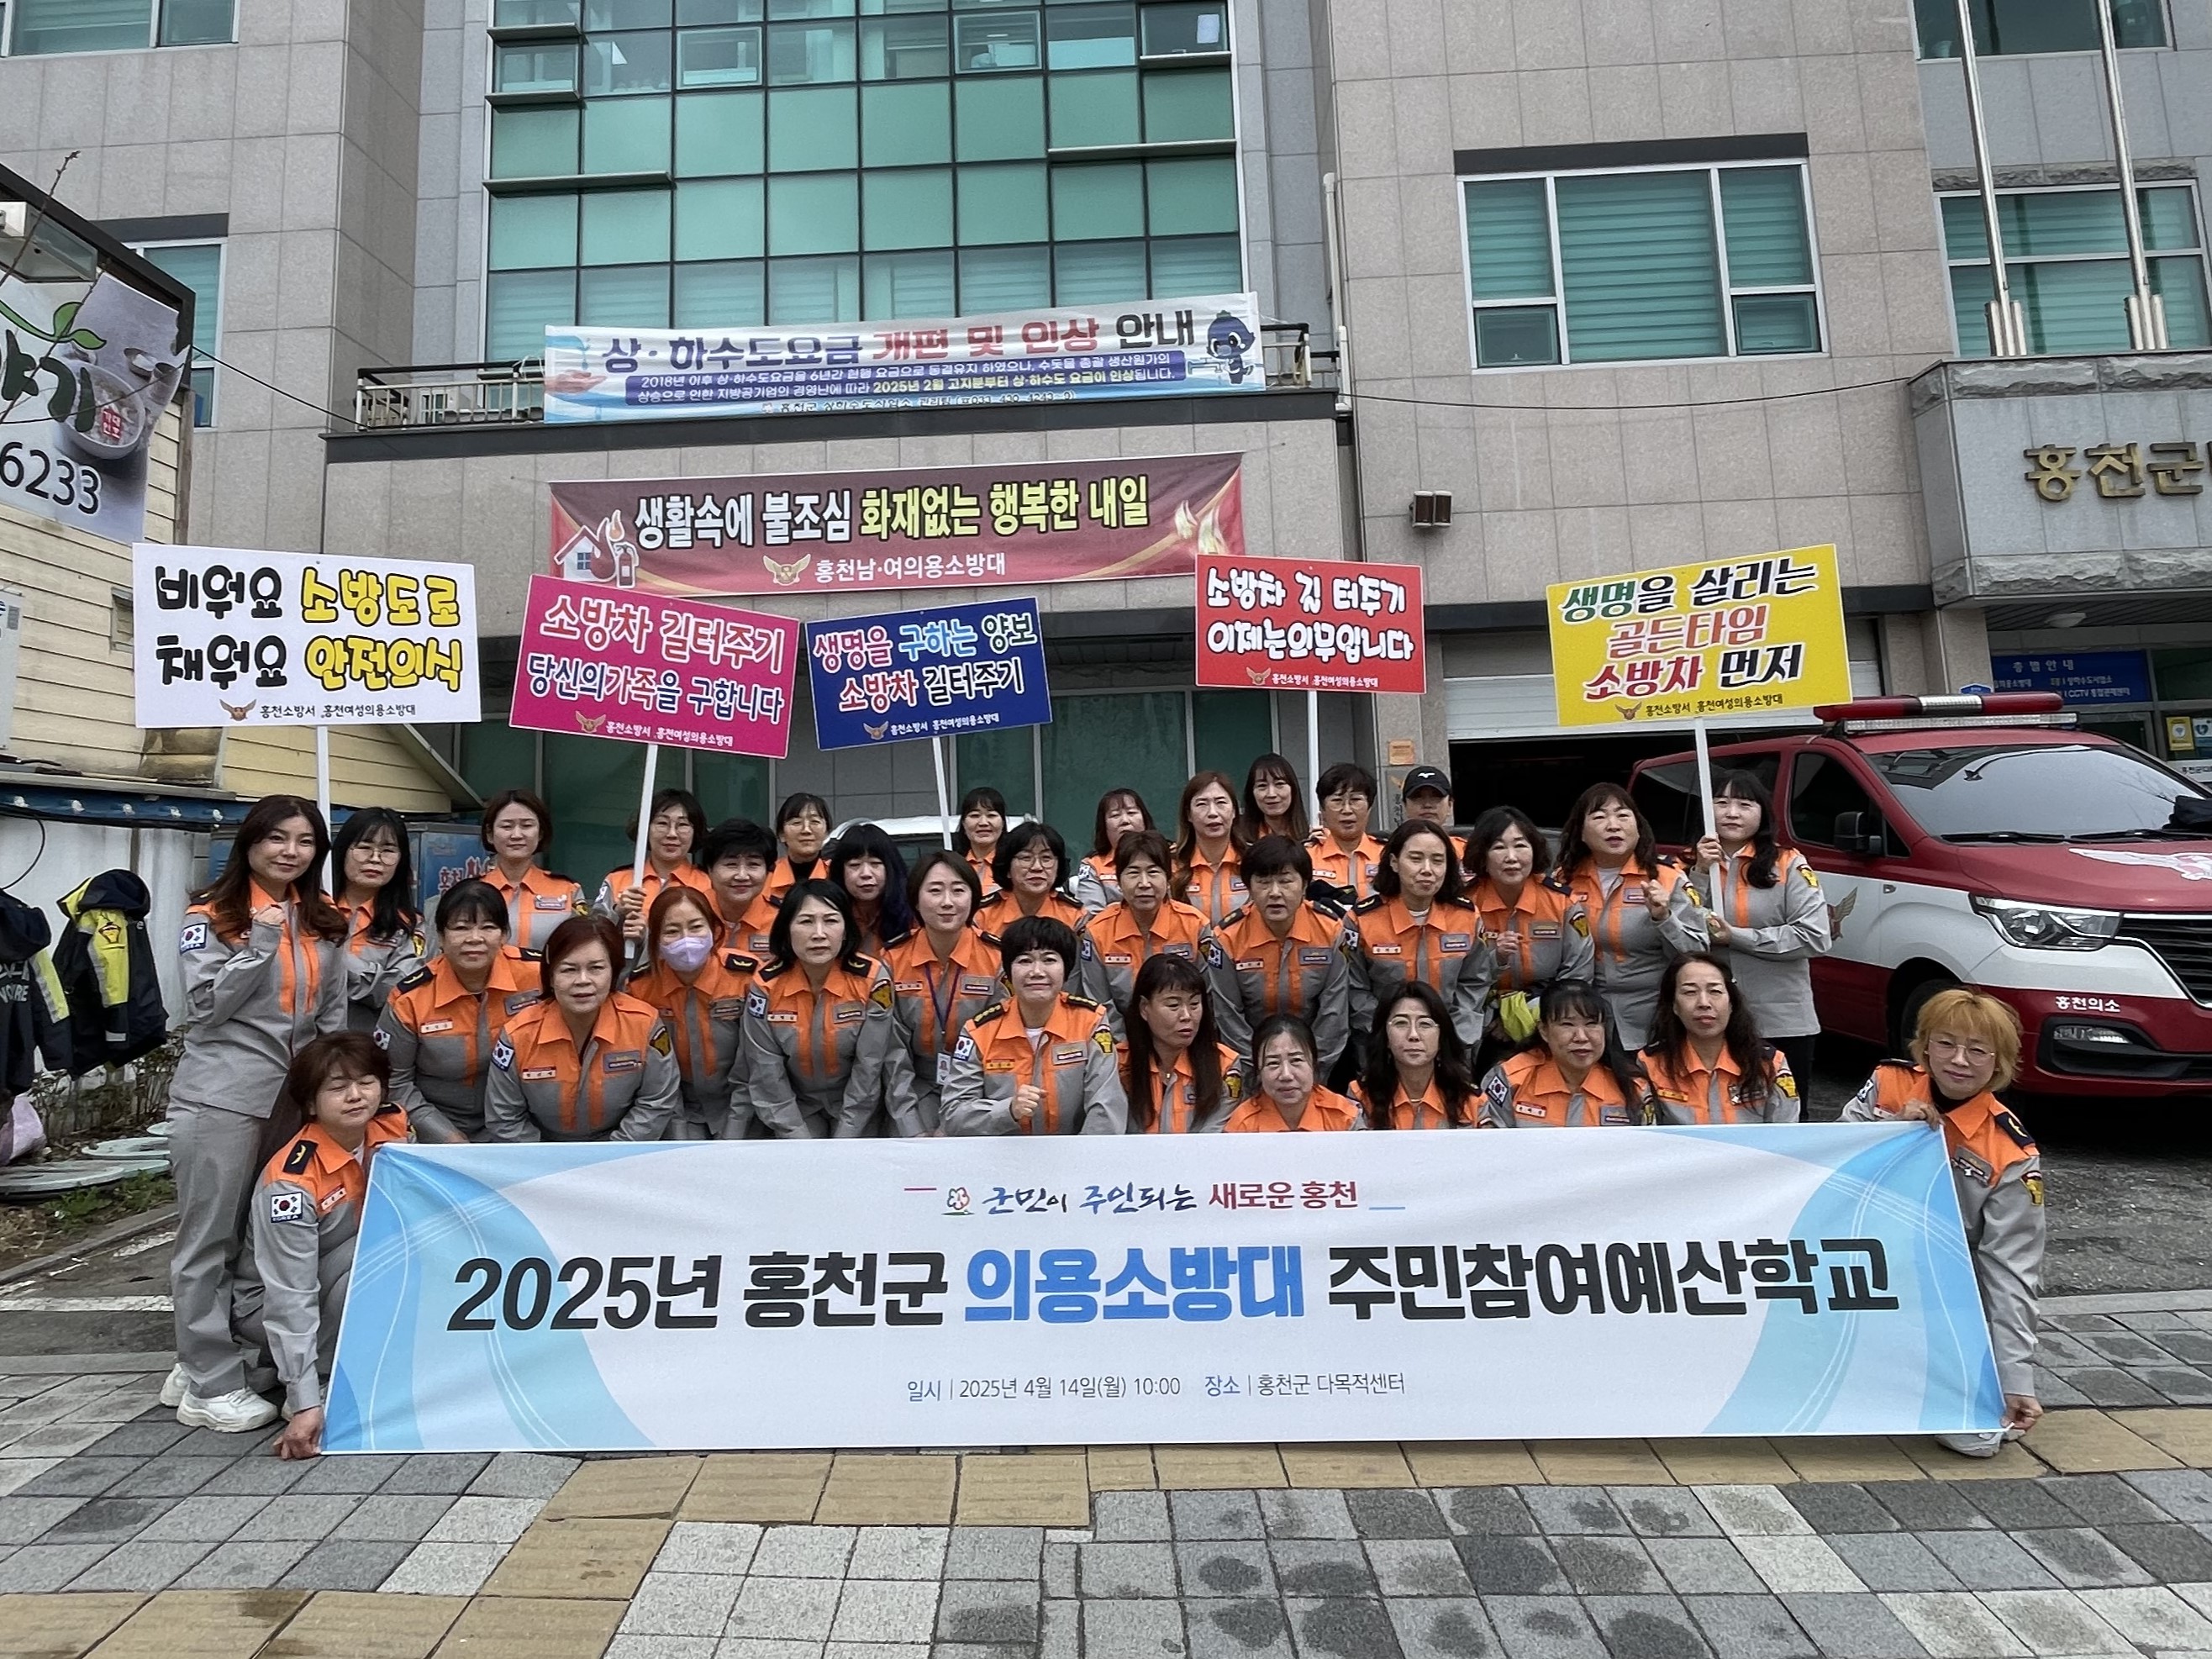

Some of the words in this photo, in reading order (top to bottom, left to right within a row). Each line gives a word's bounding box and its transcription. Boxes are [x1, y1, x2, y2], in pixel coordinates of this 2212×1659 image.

[872, 328, 950, 361] 개편
[968, 324, 1003, 358] 및
[1022, 317, 1099, 356] 인상
[1116, 308, 1194, 350] 안내
[638, 390, 685, 403] 상승으로
[689, 389, 713, 402] 인한
[717, 385, 789, 401] 지방공기업의
[793, 383, 841, 398] 경영난에
[845, 382, 869, 395] 따라
[873, 379, 921, 394] 2025년
[923, 377, 945, 392] 2월
[947, 376, 1009, 392] 고지분부터
[1069, 370, 1106, 385] 요금이
[1109, 367, 1176, 383] 인상됩니다.
[641, 377, 685, 389] 2018년
[689, 375, 712, 387] 이후
[810, 368, 844, 382] 6년간
[875, 365, 925, 378] 요금으로
[982, 359, 1035, 374] 하였으나,
[1108, 352, 1170, 368] 생산원가의
[1, 441, 100, 515] 6233
[2024, 441, 2212, 502] 홍천군
[635, 492, 755, 550] 생활속에
[762, 488, 853, 545] 불조심
[859, 484, 981, 540] 화재없는
[989, 477, 1080, 536] 행복한
[1089, 474, 1150, 529] 내일
[814, 552, 1007, 583] 홍천남·여의용소방대
[1206, 566, 1288, 612] 소방차
[1294, 571, 1323, 614] 길
[1331, 573, 1407, 618] 터주기
[1561, 575, 1676, 624] 생명을
[1690, 557, 1819, 608] 살리는
[155, 565, 282, 620] 비워요
[301, 566, 461, 629] 소방도로
[540, 594, 653, 656] 소방차
[658, 610, 786, 675] 길터주기
[813, 624, 893, 674] 생명을
[898, 619, 978, 662] 구하는
[981, 613, 1038, 655] 양보
[1206, 616, 1416, 664] 이제는의무입니다
[1609, 604, 1767, 660] 골든타임
[156, 635, 287, 690] 채워요
[304, 635, 464, 693] 안전의식
[839, 668, 919, 714] 소방차
[922, 656, 1025, 707] 길터주기
[1272, 672, 1309, 687] 홍천소방서
[1312, 674, 1379, 688] 홍천여성의용소방대
[1585, 655, 1704, 701] 소방차
[1720, 643, 1804, 688] 먼저
[259, 704, 315, 719] 홍천소방서
[323, 703, 417, 719] 홍천여성의용소방대
[687, 676, 786, 724] 구합니다
[1646, 703, 1691, 717] 홍천소방서
[1696, 693, 1783, 714] 홍천여성의용소방대
[2069, 688, 2089, 698] CCTV
[605, 721, 651, 738] 홍천소방서
[656, 726, 734, 747] 홍천여성의용소방대
[890, 721, 929, 736] 홍천소방서
[932, 713, 1000, 731] 홍천여성의용소방대
[2056, 994, 2121, 1014] 홍천의소
[982, 1186, 1068, 1216] 군민이
[1078, 1182, 1198, 1215] 주인되는
[1209, 1182, 1294, 1210] 새로운
[1300, 1181, 1358, 1209] 홍천
[447, 1253, 719, 1333] 2025년
[743, 1250, 949, 1327] 홍천군
[964, 1245, 1306, 1325] 의용소방대
[1328, 1237, 1900, 1321] 주민참여예산학교
[907, 1379, 942, 1403] 일시
[959, 1376, 1018, 1398] 2025년
[1023, 1375, 1053, 1398] 4월
[1058, 1374, 1128, 1398] 14일(월)
[1133, 1375, 1181, 1396] 10:00
[1204, 1374, 1242, 1396] 장소
[1257, 1373, 1311, 1397] 홍천군
[1316, 1372, 1406, 1396] 다목적센터
